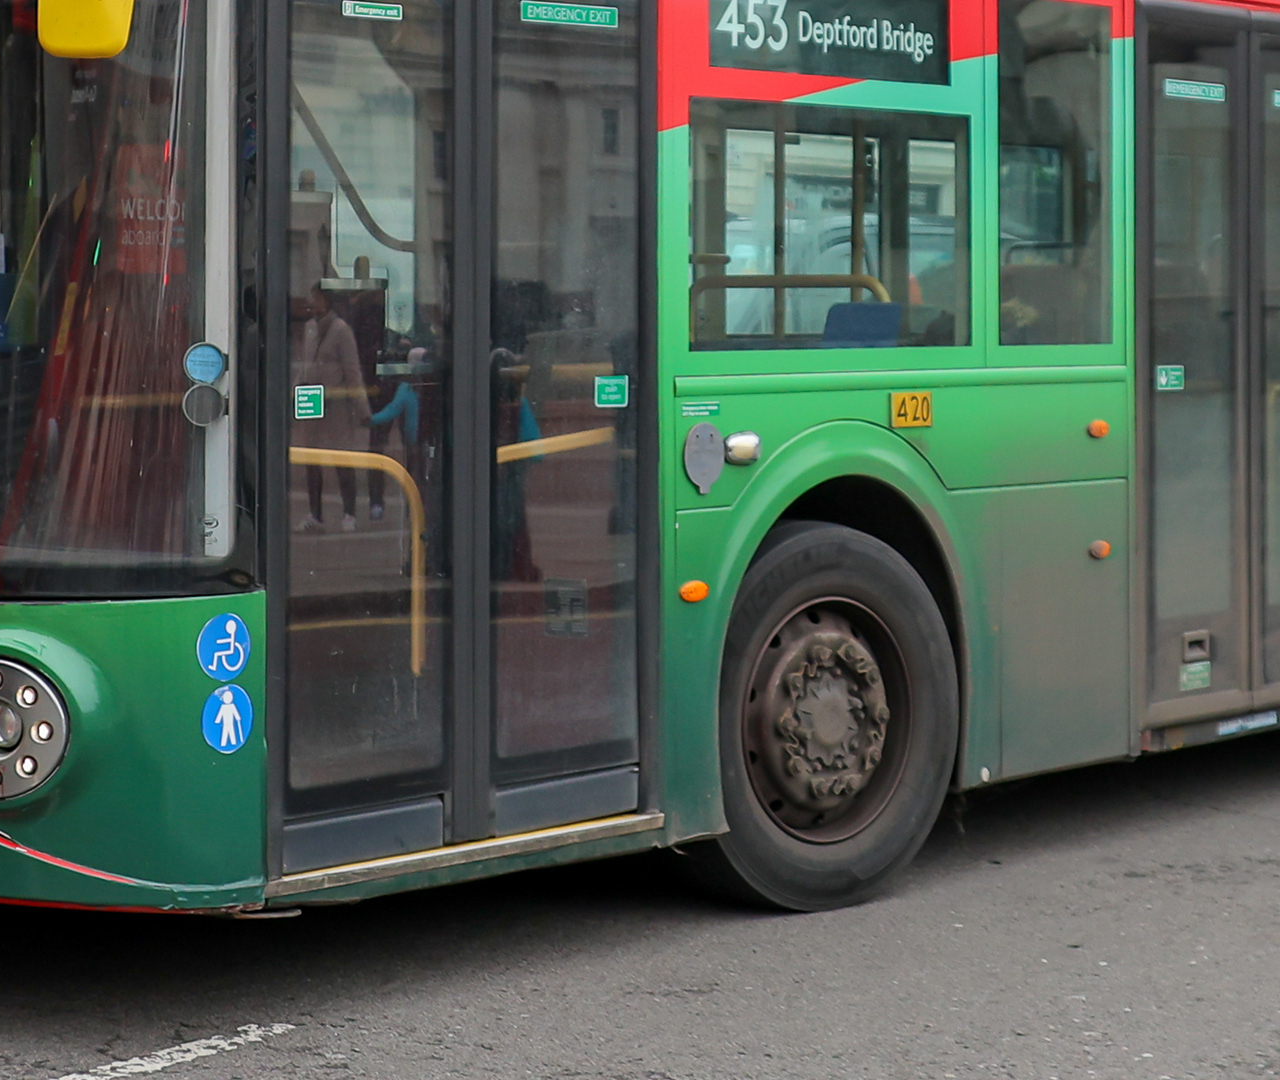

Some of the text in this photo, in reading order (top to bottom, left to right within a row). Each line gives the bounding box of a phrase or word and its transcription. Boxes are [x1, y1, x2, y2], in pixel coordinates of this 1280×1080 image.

[355, 5, 398, 17] Emergency exit
[527, 6, 611, 23] EMERGENCY EXIT
[797, 10, 878, 57] Deptford
[881, 17, 934, 64] Bridge
[1173, 82, 1224, 97] EMERGENCY EXIT
[897, 395, 929, 422] 420
